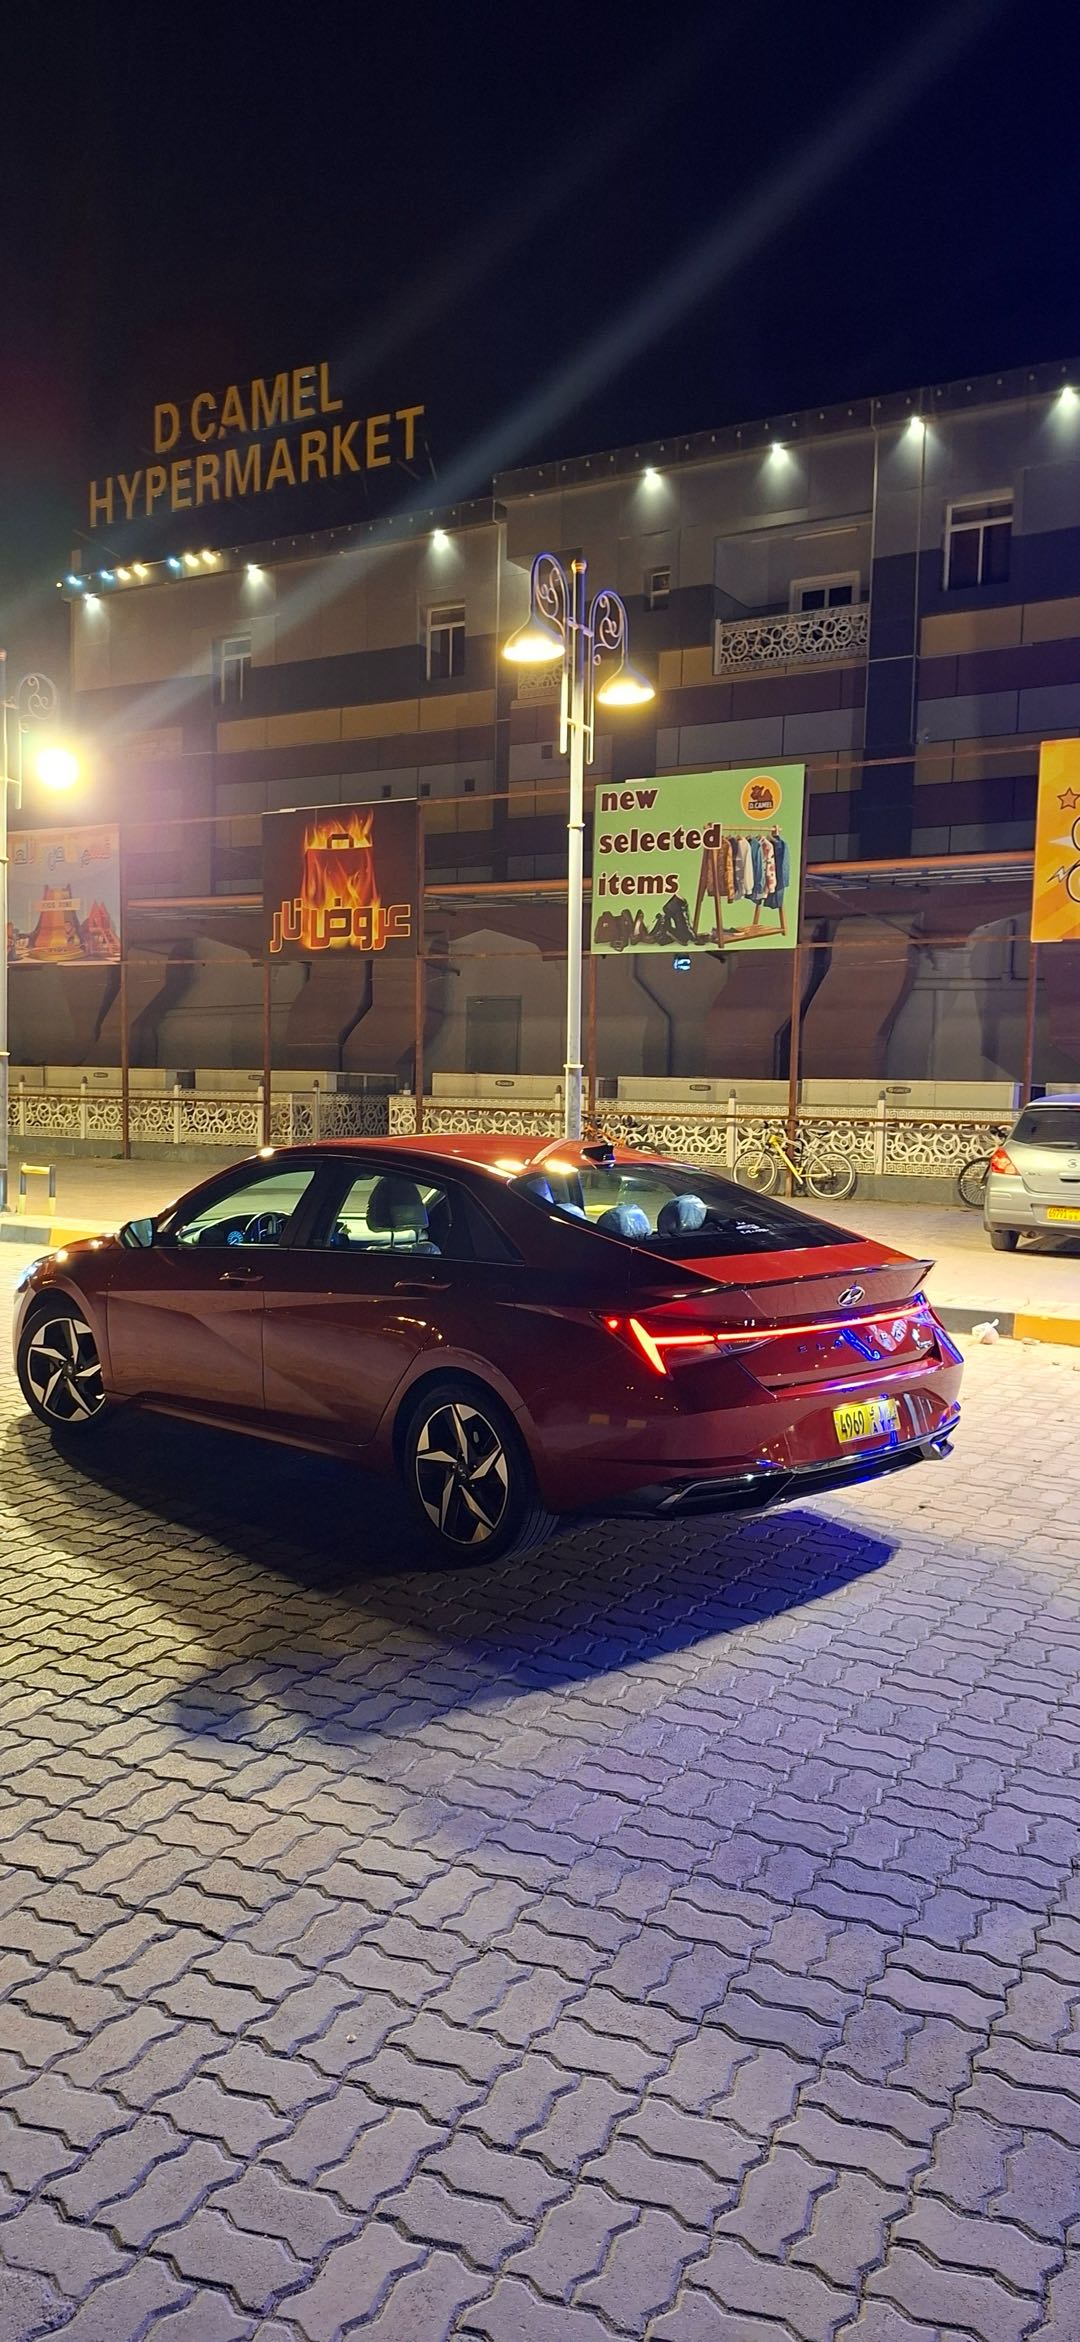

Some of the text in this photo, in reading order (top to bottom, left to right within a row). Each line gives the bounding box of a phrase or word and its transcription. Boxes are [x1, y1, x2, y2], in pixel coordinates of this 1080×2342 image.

[154, 362, 343, 453] D CAMEL
[89, 405, 425, 528] HYPERMARKET
[601, 788, 659, 812] new
[599, 823, 722, 853] selected
[598, 872, 679, 896] items
[269, 897, 411, 953] عروض نار
[839, 1410, 865, 1438] 4969
